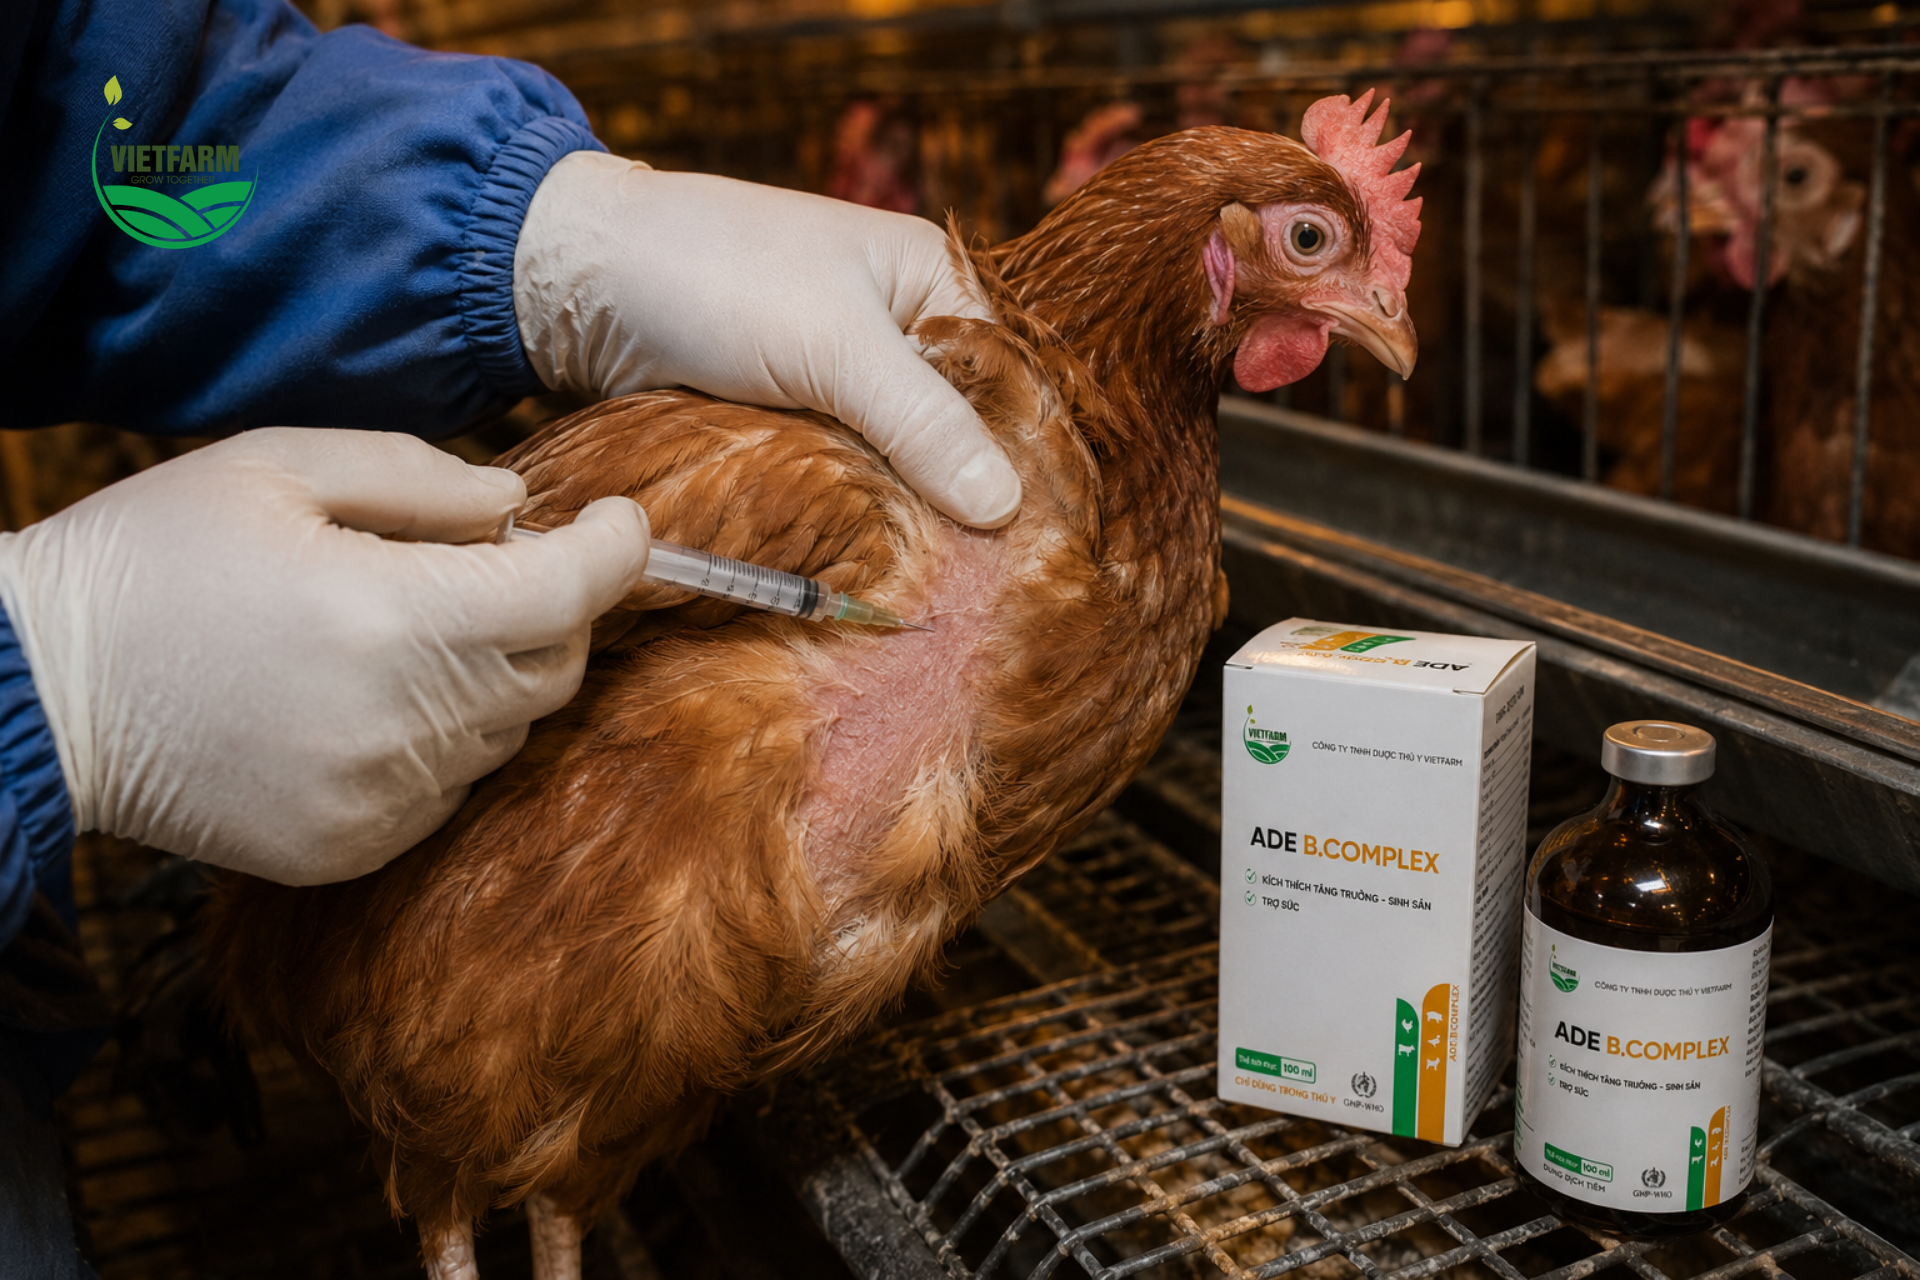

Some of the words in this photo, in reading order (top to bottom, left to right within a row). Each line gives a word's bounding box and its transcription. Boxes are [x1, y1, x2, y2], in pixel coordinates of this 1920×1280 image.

[1248, 727, 1287, 742] VIETFARM
[1312, 740, 1336, 752] CÔNG
[1338, 744, 1348, 753] TY
[1416, 754, 1424, 763] Y
[1424, 755, 1463, 767] VIETFARM
[1250, 826, 1297, 853] ADE
[1303, 834, 1440, 875] B.COMPLEX
[1284, 879, 1311, 892] THÍCH
[1388, 896, 1409, 908] SINH
[1594, 980, 1618, 992] CÔNG
[1619, 984, 1630, 993] TY
[1694, 988, 1700, 996] Y
[1554, 1020, 1601, 1052] ADE
[1606, 1035, 1730, 1061] B.COMPLEX
[1283, 1063, 1299, 1075] 100
[1301, 1067, 1313, 1077] ml
[1329, 1095, 1337, 1104] Y
[1583, 1162, 1598, 1174] 100
